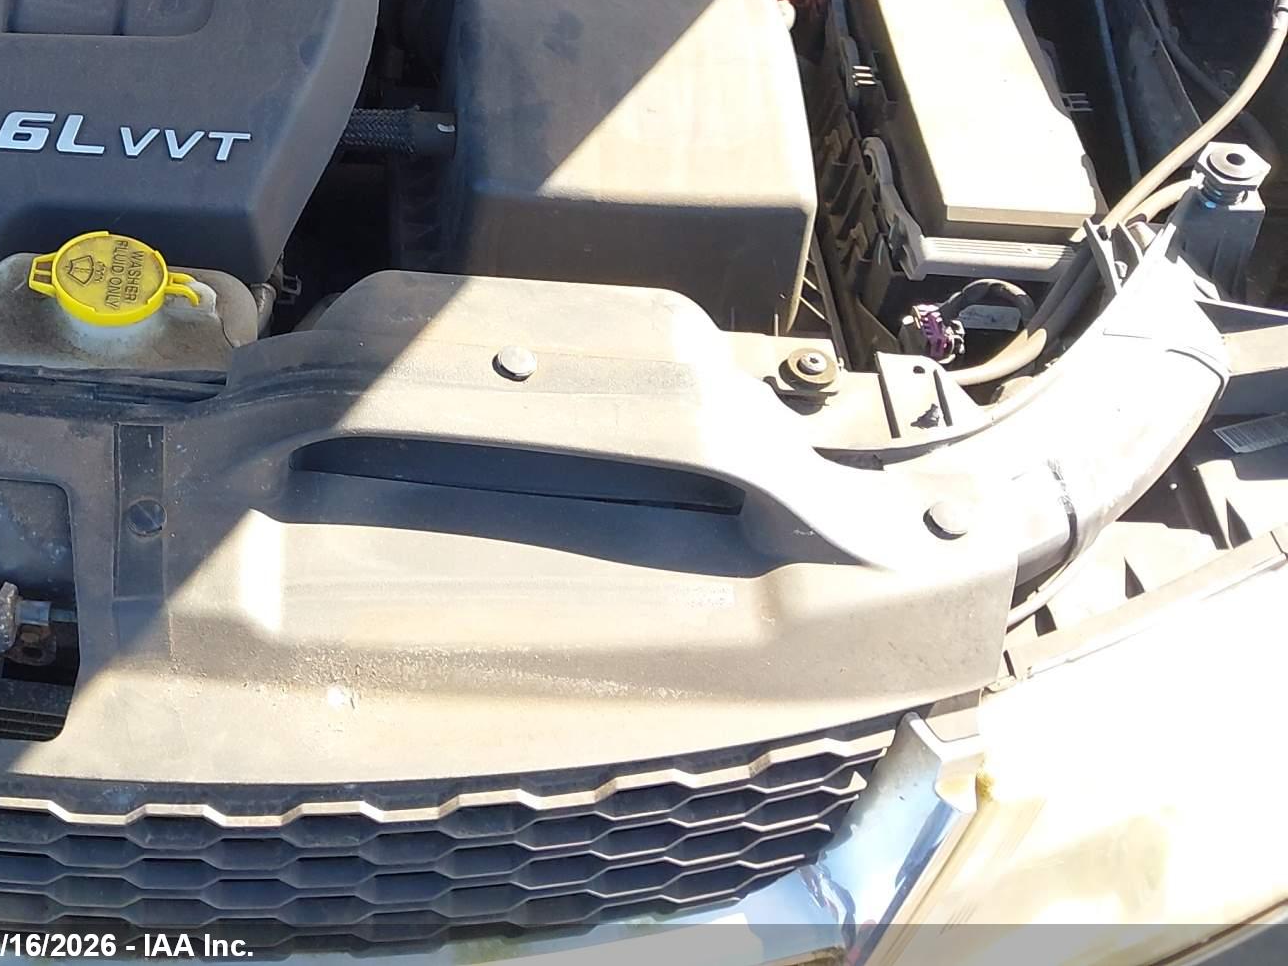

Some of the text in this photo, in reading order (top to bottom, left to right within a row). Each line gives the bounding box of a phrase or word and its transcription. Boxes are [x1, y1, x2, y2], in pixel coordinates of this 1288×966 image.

[120, 127, 252, 162] VVT
[105, 239, 129, 311] FLUID ONLY
[124, 250, 145, 304] WASHER
